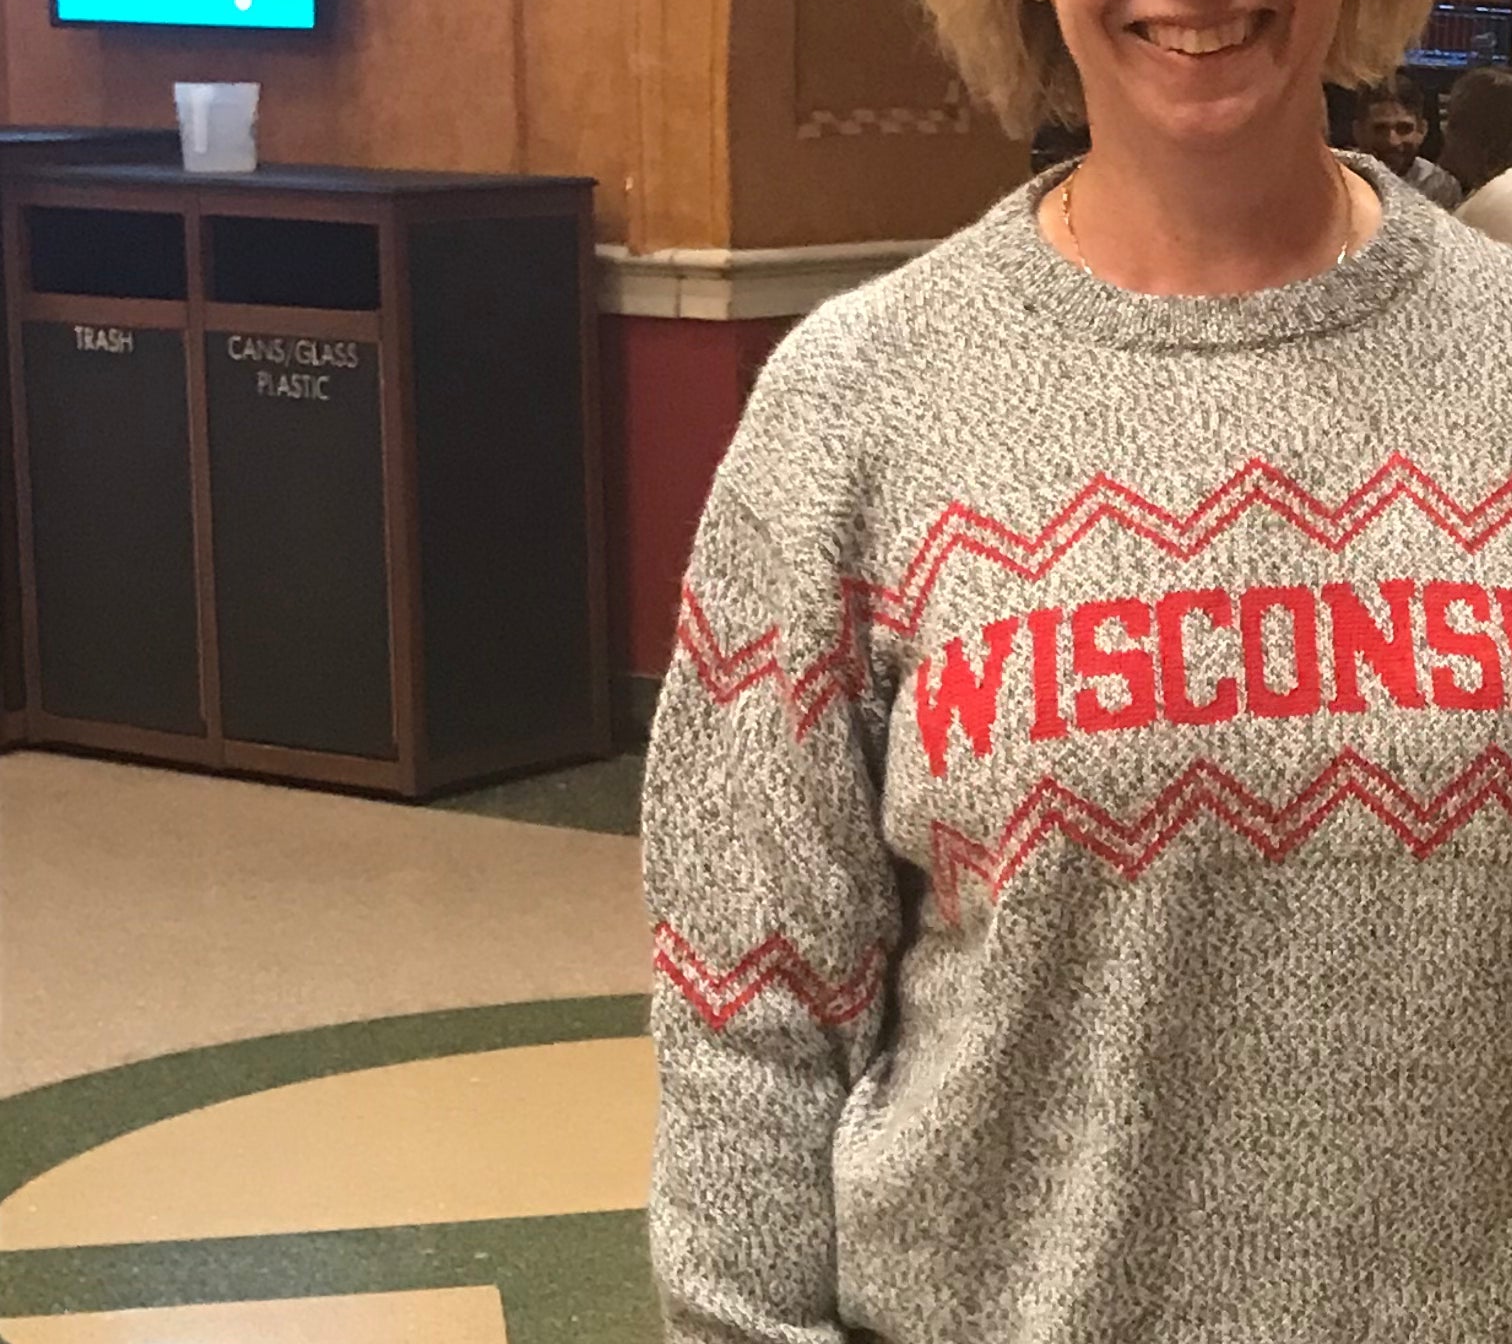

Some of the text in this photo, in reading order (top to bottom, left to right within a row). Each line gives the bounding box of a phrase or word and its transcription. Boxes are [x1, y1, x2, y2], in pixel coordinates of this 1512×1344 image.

[74, 324, 134, 353] TRASH
[227, 335, 359, 369] CANS/GLASS
[256, 370, 331, 401] PLASTIC
